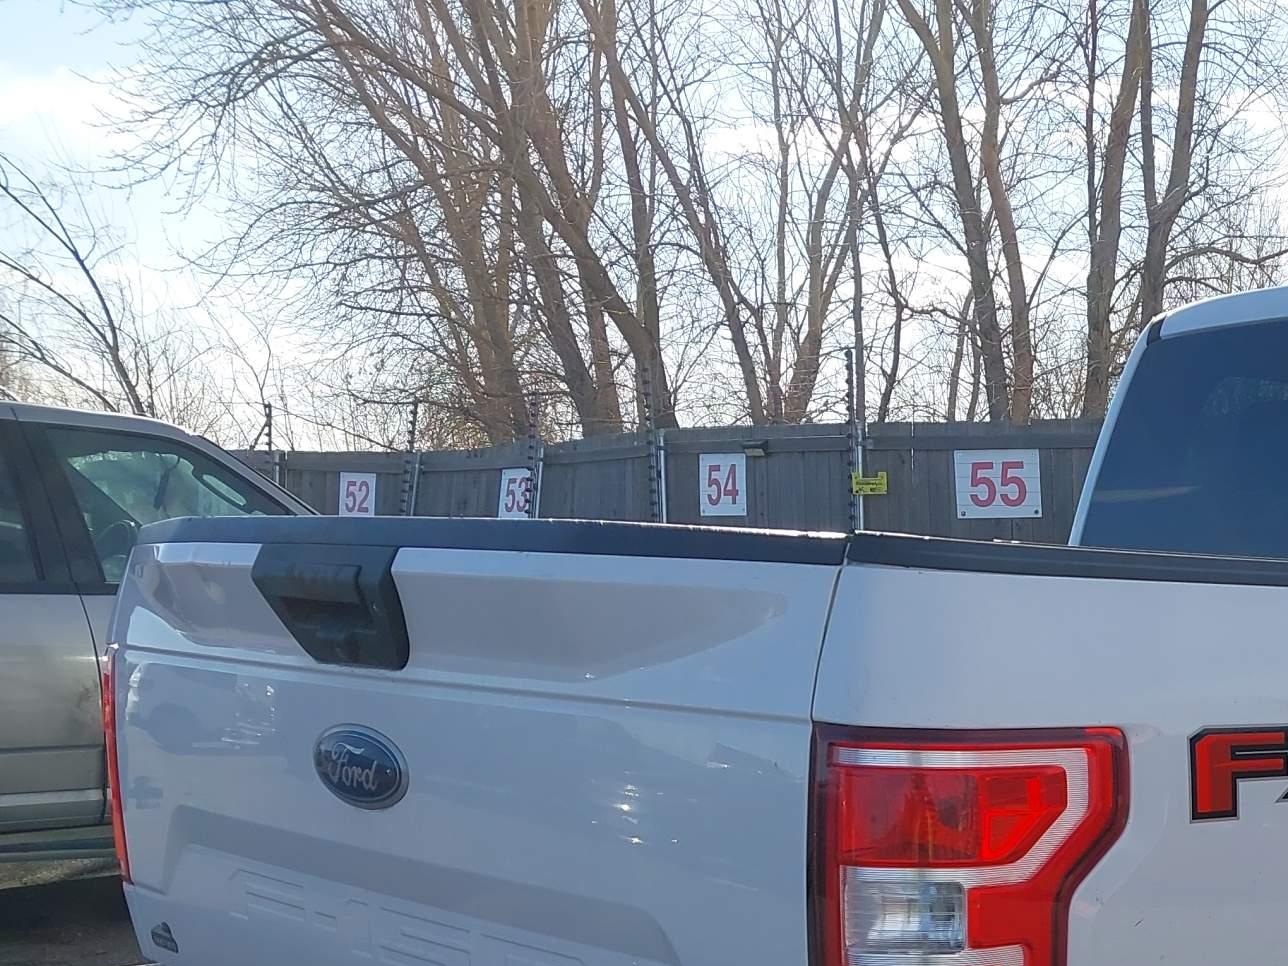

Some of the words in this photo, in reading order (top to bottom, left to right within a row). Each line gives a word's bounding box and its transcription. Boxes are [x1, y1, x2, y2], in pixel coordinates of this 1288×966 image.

[345, 480, 370, 513] 52
[504, 478, 530, 513] 53
[707, 464, 739, 506] 54
[970, 462, 1027, 508] 55
[328, 742, 378, 791] Ford
